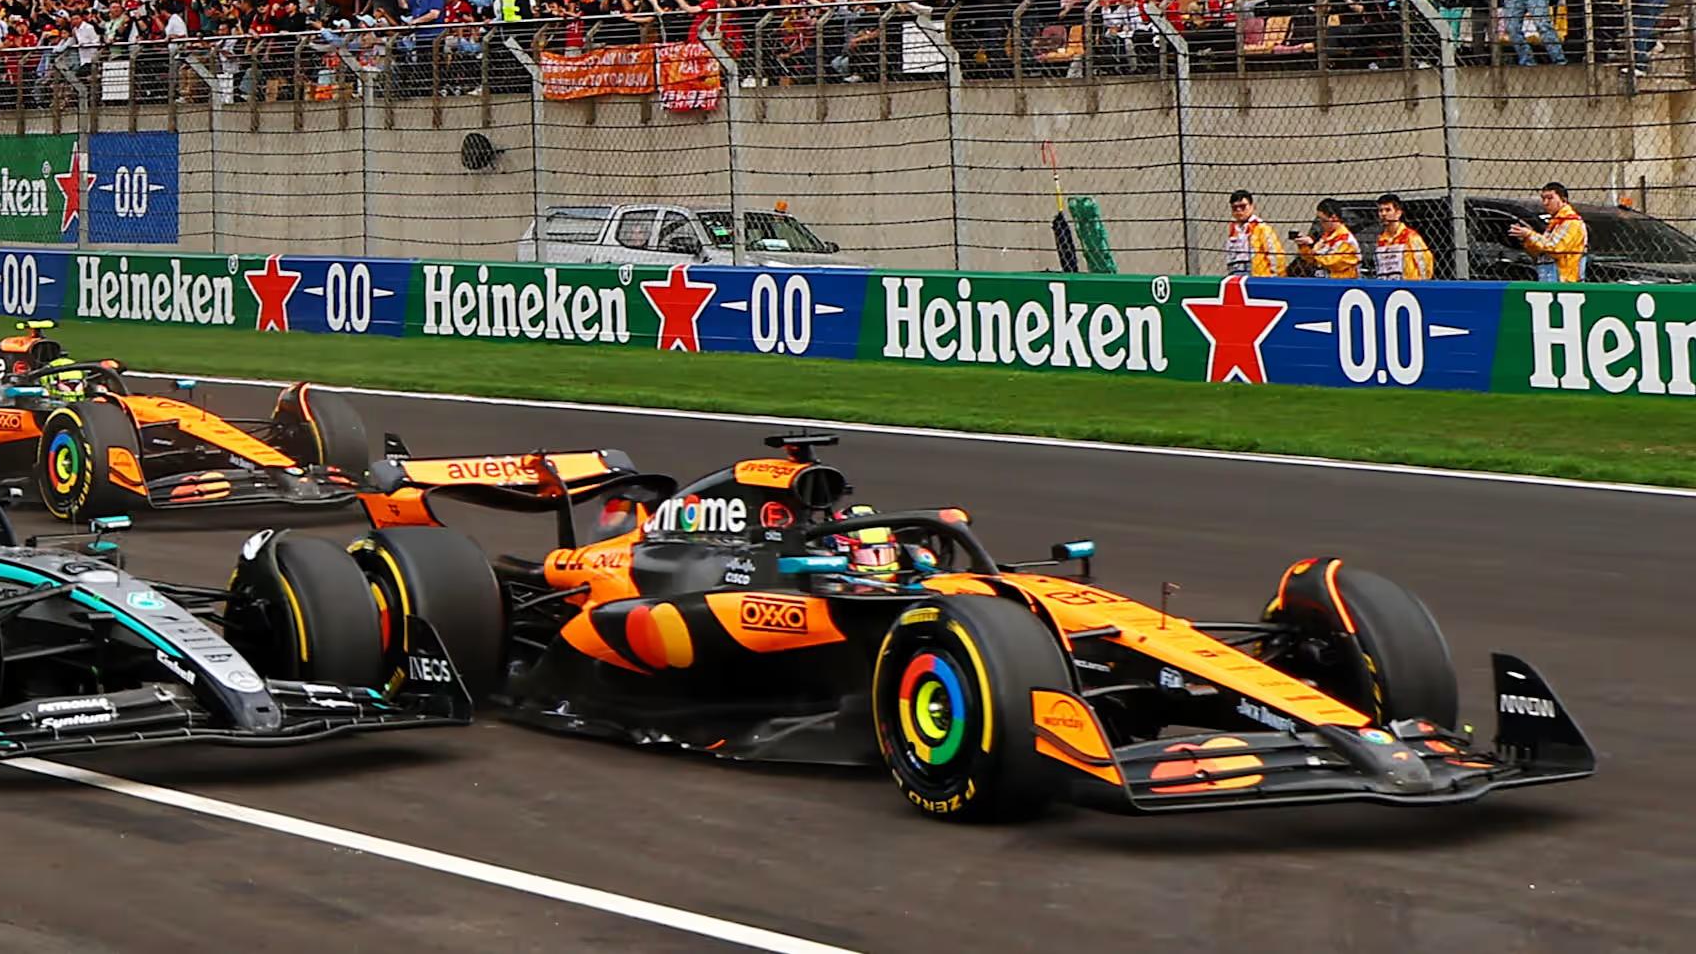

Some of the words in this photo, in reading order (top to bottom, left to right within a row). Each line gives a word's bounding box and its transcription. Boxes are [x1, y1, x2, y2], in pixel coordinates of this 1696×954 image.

[114, 165, 149, 218] 0.0
[2, 253, 38, 316] 0.0
[76, 255, 236, 325] Heineken
[325, 262, 372, 333] 0.0
[422, 264, 631, 344] Heineken
[751, 273, 812, 355] 0.0
[881, 276, 1169, 373] Heineken
[1337, 288, 1424, 386] 0.0
[741, 601, 807, 628] OXXO
[408, 656, 452, 682] INEOS
[40, 713, 112, 730] Syntium
[908, 790, 963, 814] ZERO
